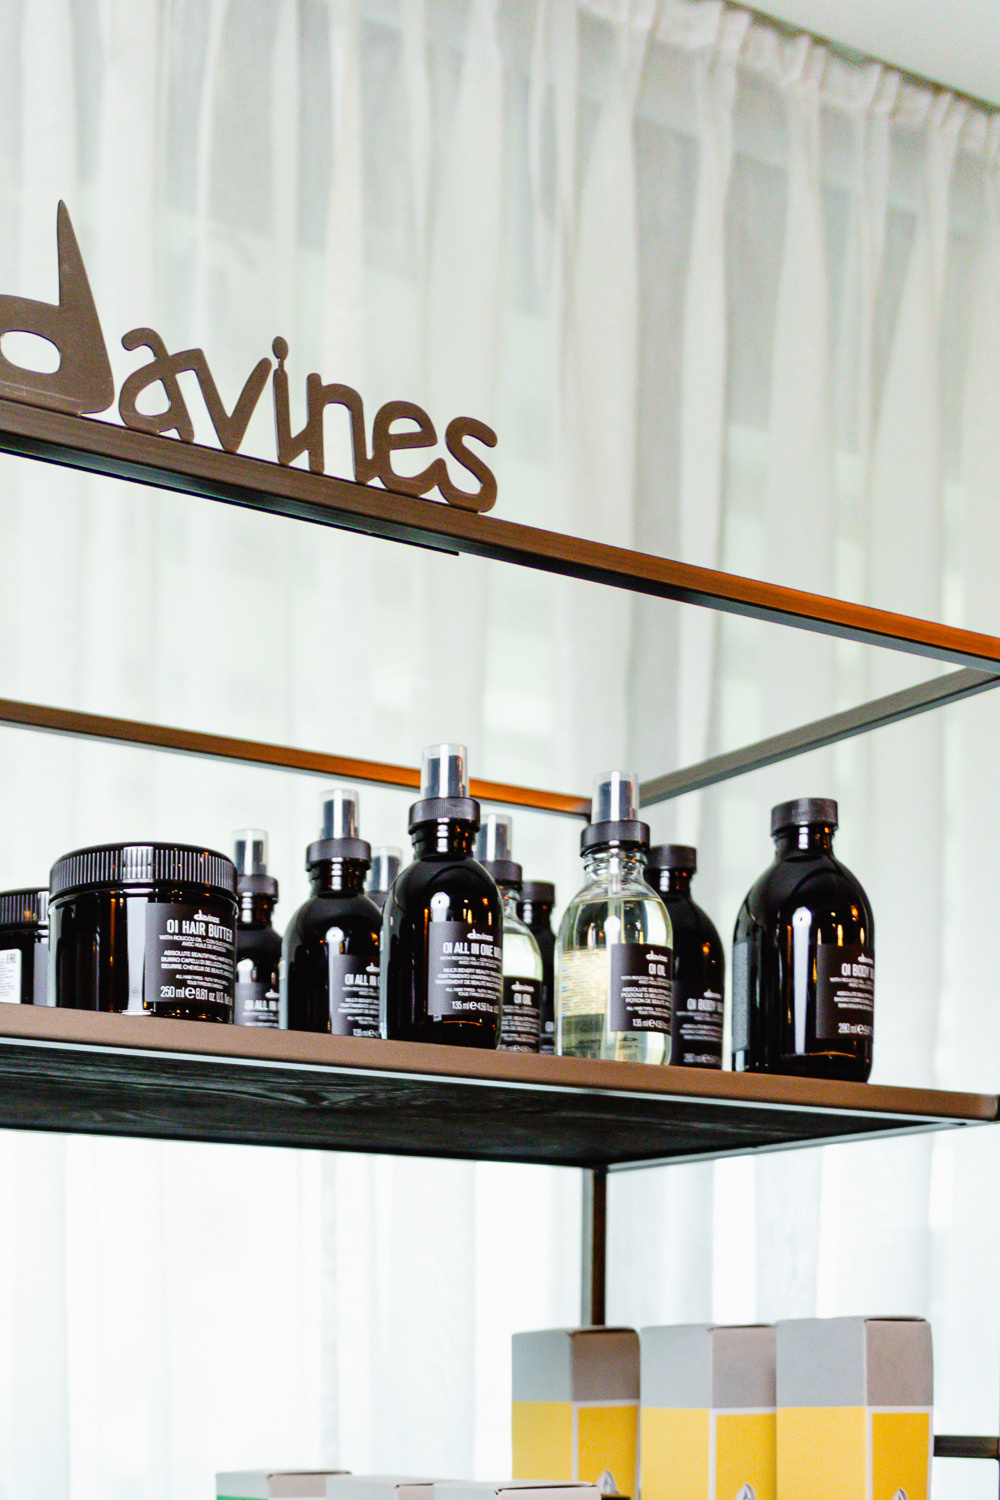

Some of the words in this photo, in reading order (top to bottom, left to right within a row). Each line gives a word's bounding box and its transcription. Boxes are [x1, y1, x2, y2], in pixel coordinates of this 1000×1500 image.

[167, 919, 178, 933] OI
[182, 920, 205, 935] HAIR
[208, 924, 232, 942] BUTTER
[443, 942, 452, 954] OI
[454, 942, 470, 954] ALL
[472, 943, 479, 956] IN
[480, 944, 493, 957] ONE
[160, 986, 175, 997] 250
